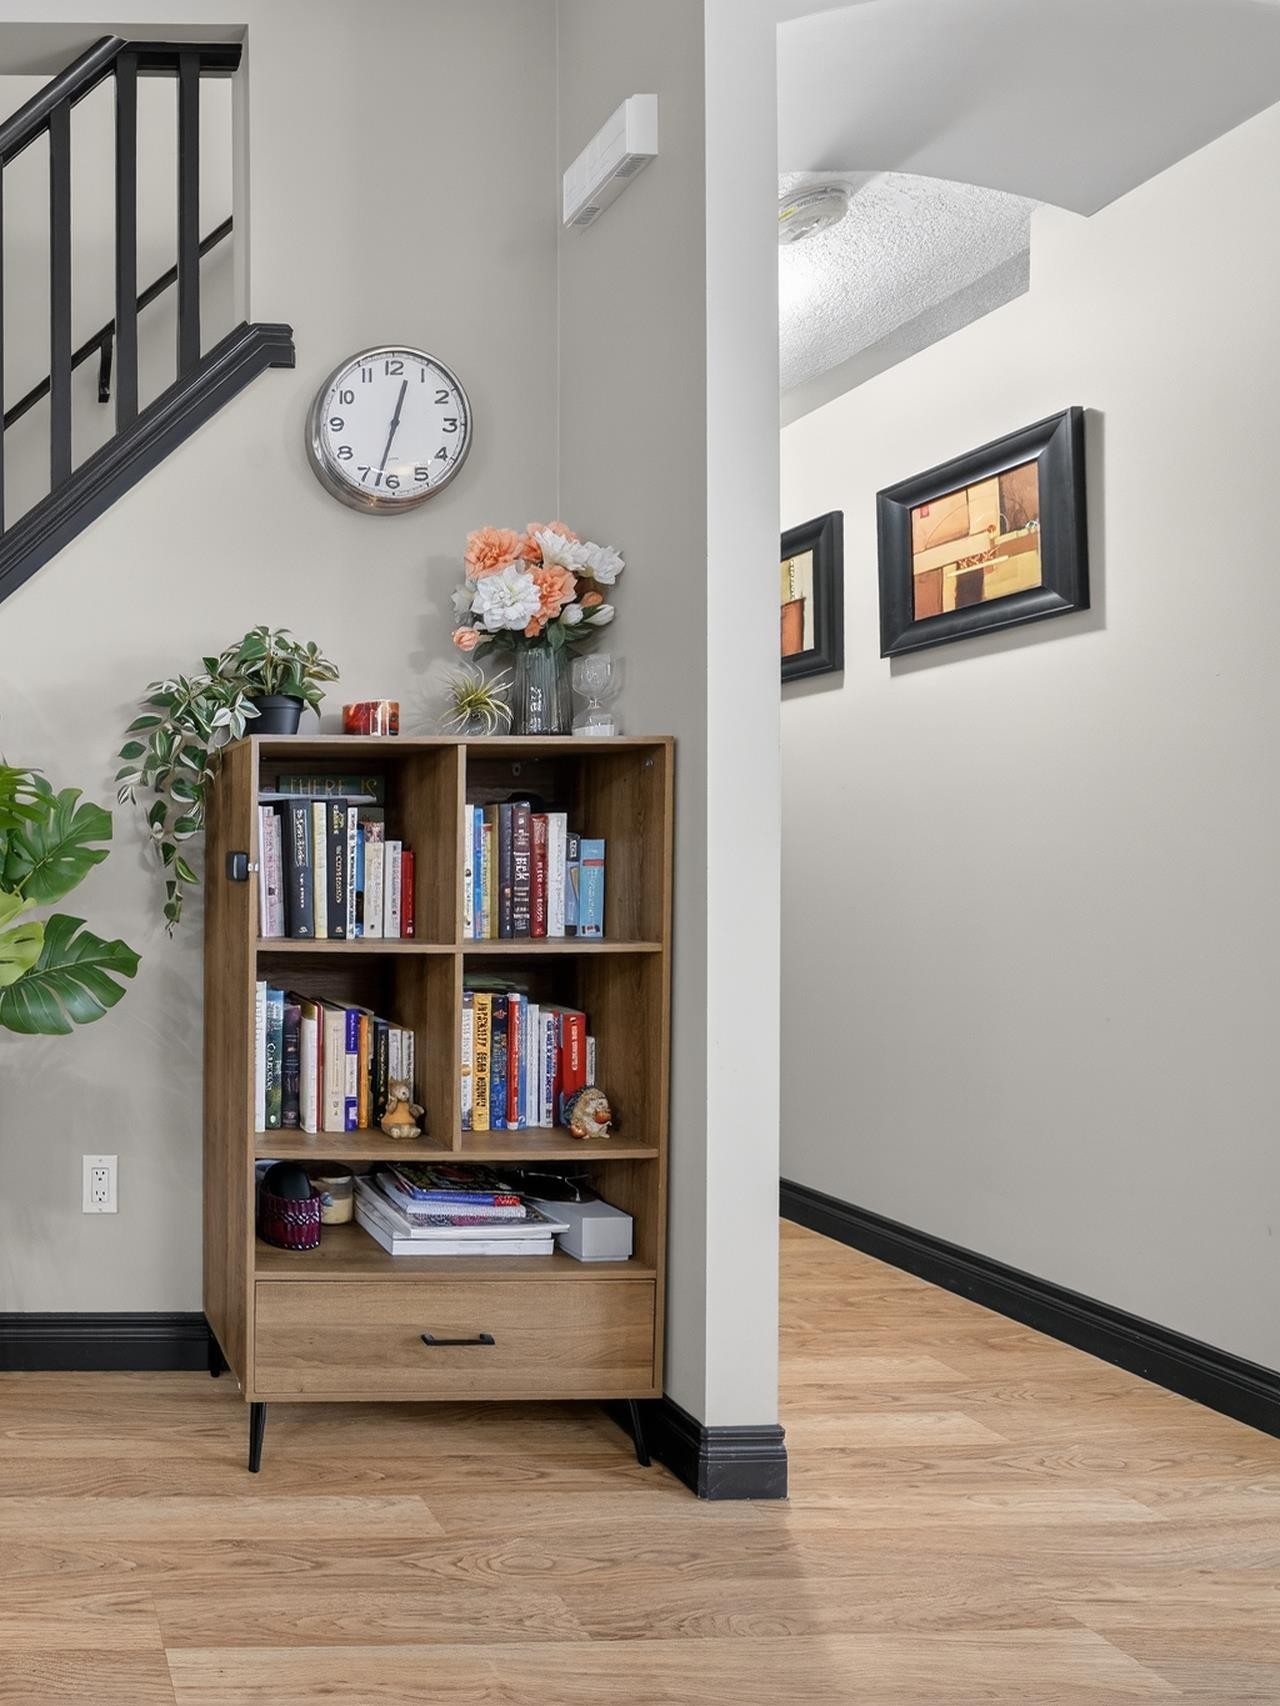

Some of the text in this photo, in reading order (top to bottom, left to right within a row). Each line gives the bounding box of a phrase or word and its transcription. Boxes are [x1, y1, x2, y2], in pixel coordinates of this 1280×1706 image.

[385, 361, 404, 375] 12
[362, 368, 372, 383] 11
[339, 390, 354, 404] 10
[434, 390, 449, 404] 2
[329, 417, 344, 431] 9
[442, 417, 458, 433] 3
[337, 446, 353, 460] 8
[434, 447, 448, 461] 4
[357, 466, 371, 482] 7
[414, 467, 429, 481] 5
[385, 475, 400, 489] 6
